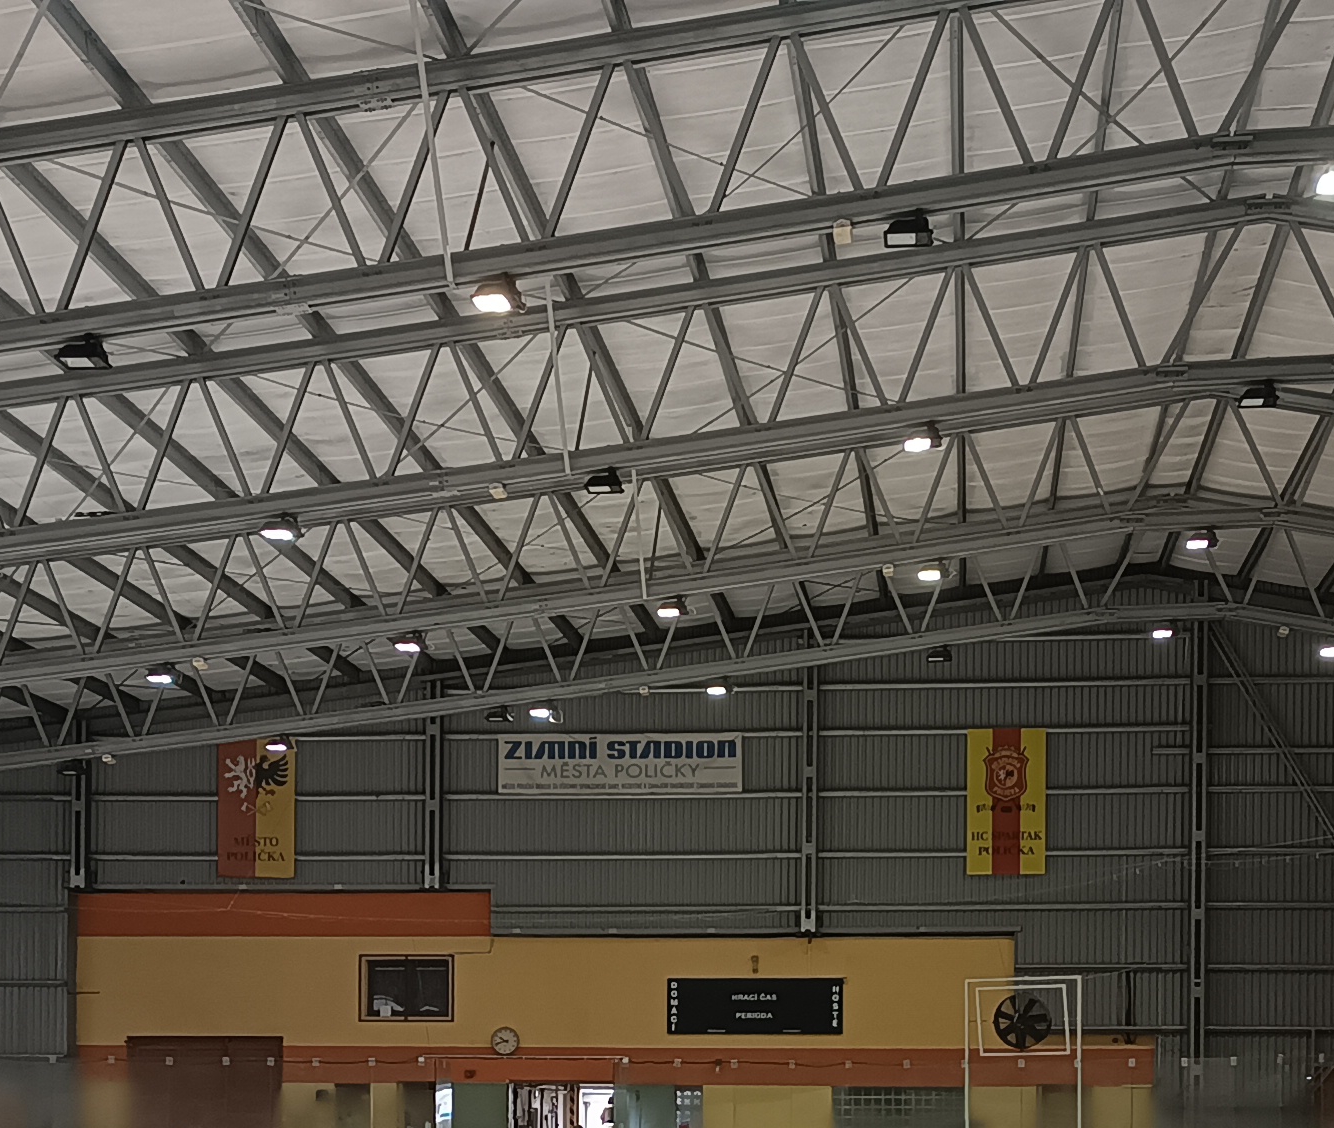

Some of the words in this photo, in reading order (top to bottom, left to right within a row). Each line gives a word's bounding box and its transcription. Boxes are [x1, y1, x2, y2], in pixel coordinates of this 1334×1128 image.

[504, 736, 598, 760] ZIMNÍ
[607, 740, 737, 760] STADION
[541, 762, 608, 778] MĚSTA
[615, 761, 700, 778] POLIČKY
[233, 836, 279, 847] MĚSTO
[971, 831, 989, 841] HC
[227, 850, 286, 862] POLIČKA
